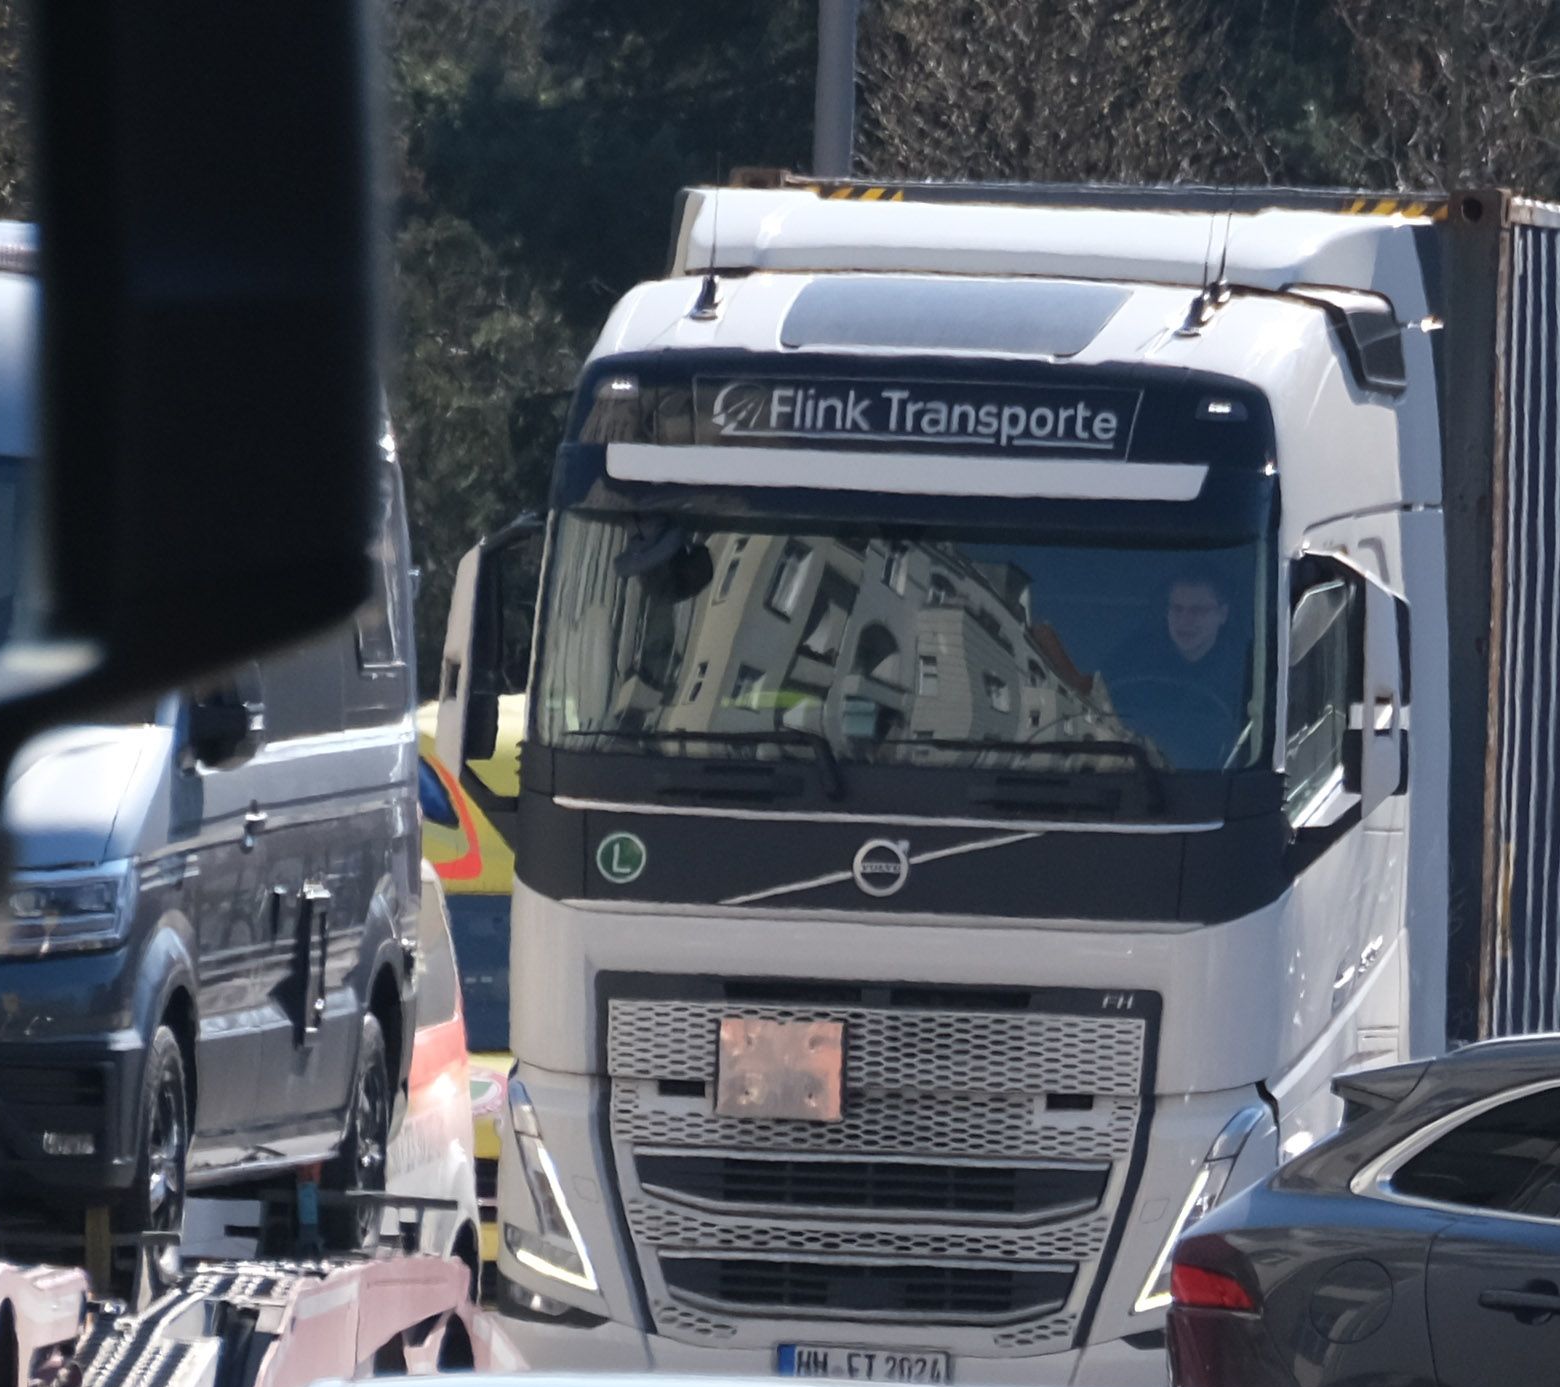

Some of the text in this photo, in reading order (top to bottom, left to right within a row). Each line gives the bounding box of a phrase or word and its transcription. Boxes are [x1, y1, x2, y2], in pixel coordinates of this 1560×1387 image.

[769, 387, 1118, 447] Flink Transporte
[612, 843, 632, 874] L
[796, 1350, 829, 1376] HH
